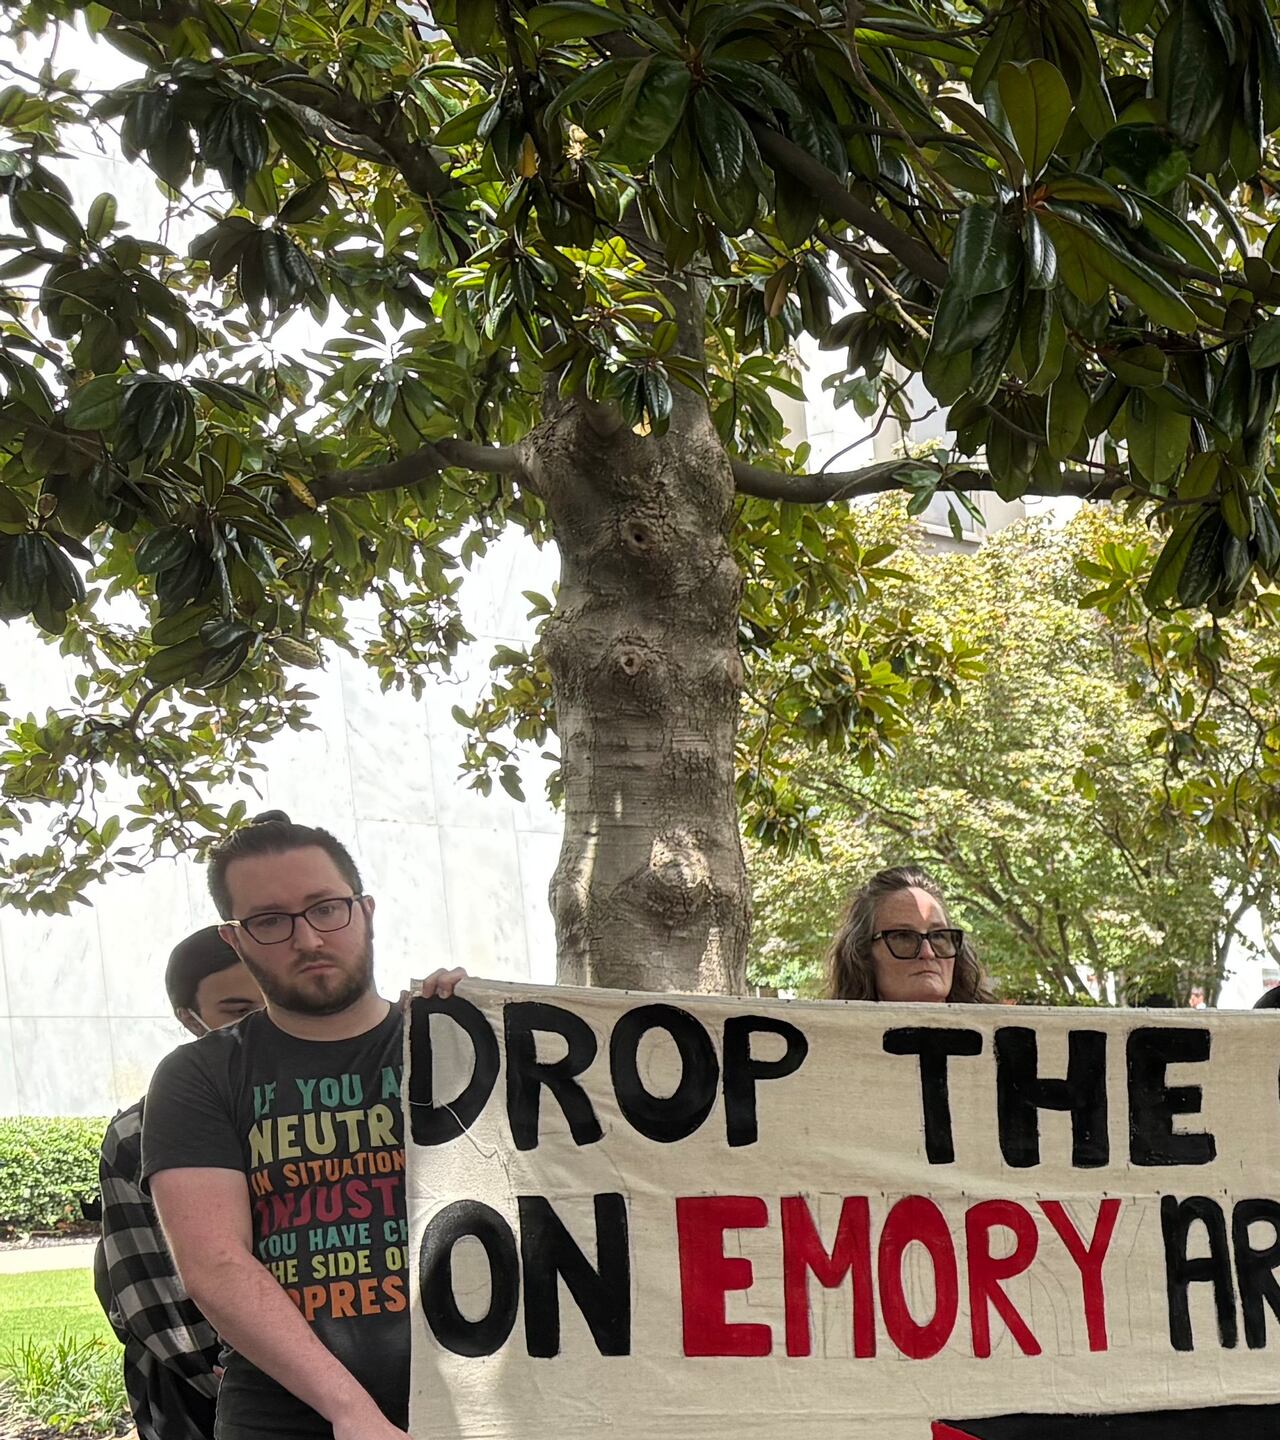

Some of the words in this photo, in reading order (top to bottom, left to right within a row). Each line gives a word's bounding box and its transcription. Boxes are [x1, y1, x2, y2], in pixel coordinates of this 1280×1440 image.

[253, 1081, 277, 1120] IF
[296, 1073, 363, 1110] YOU
[381, 1065, 403, 1099] A
[407, 995, 808, 1151] DROP
[882, 1026, 1217, 1169] THE
[251, 1169, 274, 1197] IN
[258, 1232, 297, 1260] YOU
[309, 1223, 371, 1251] HAVE
[264, 1258, 299, 1285] HE
[311, 1250, 371, 1280] SIDE
[419, 1193, 631, 1358] ON
[676, 1196, 1121, 1360] EMORY
